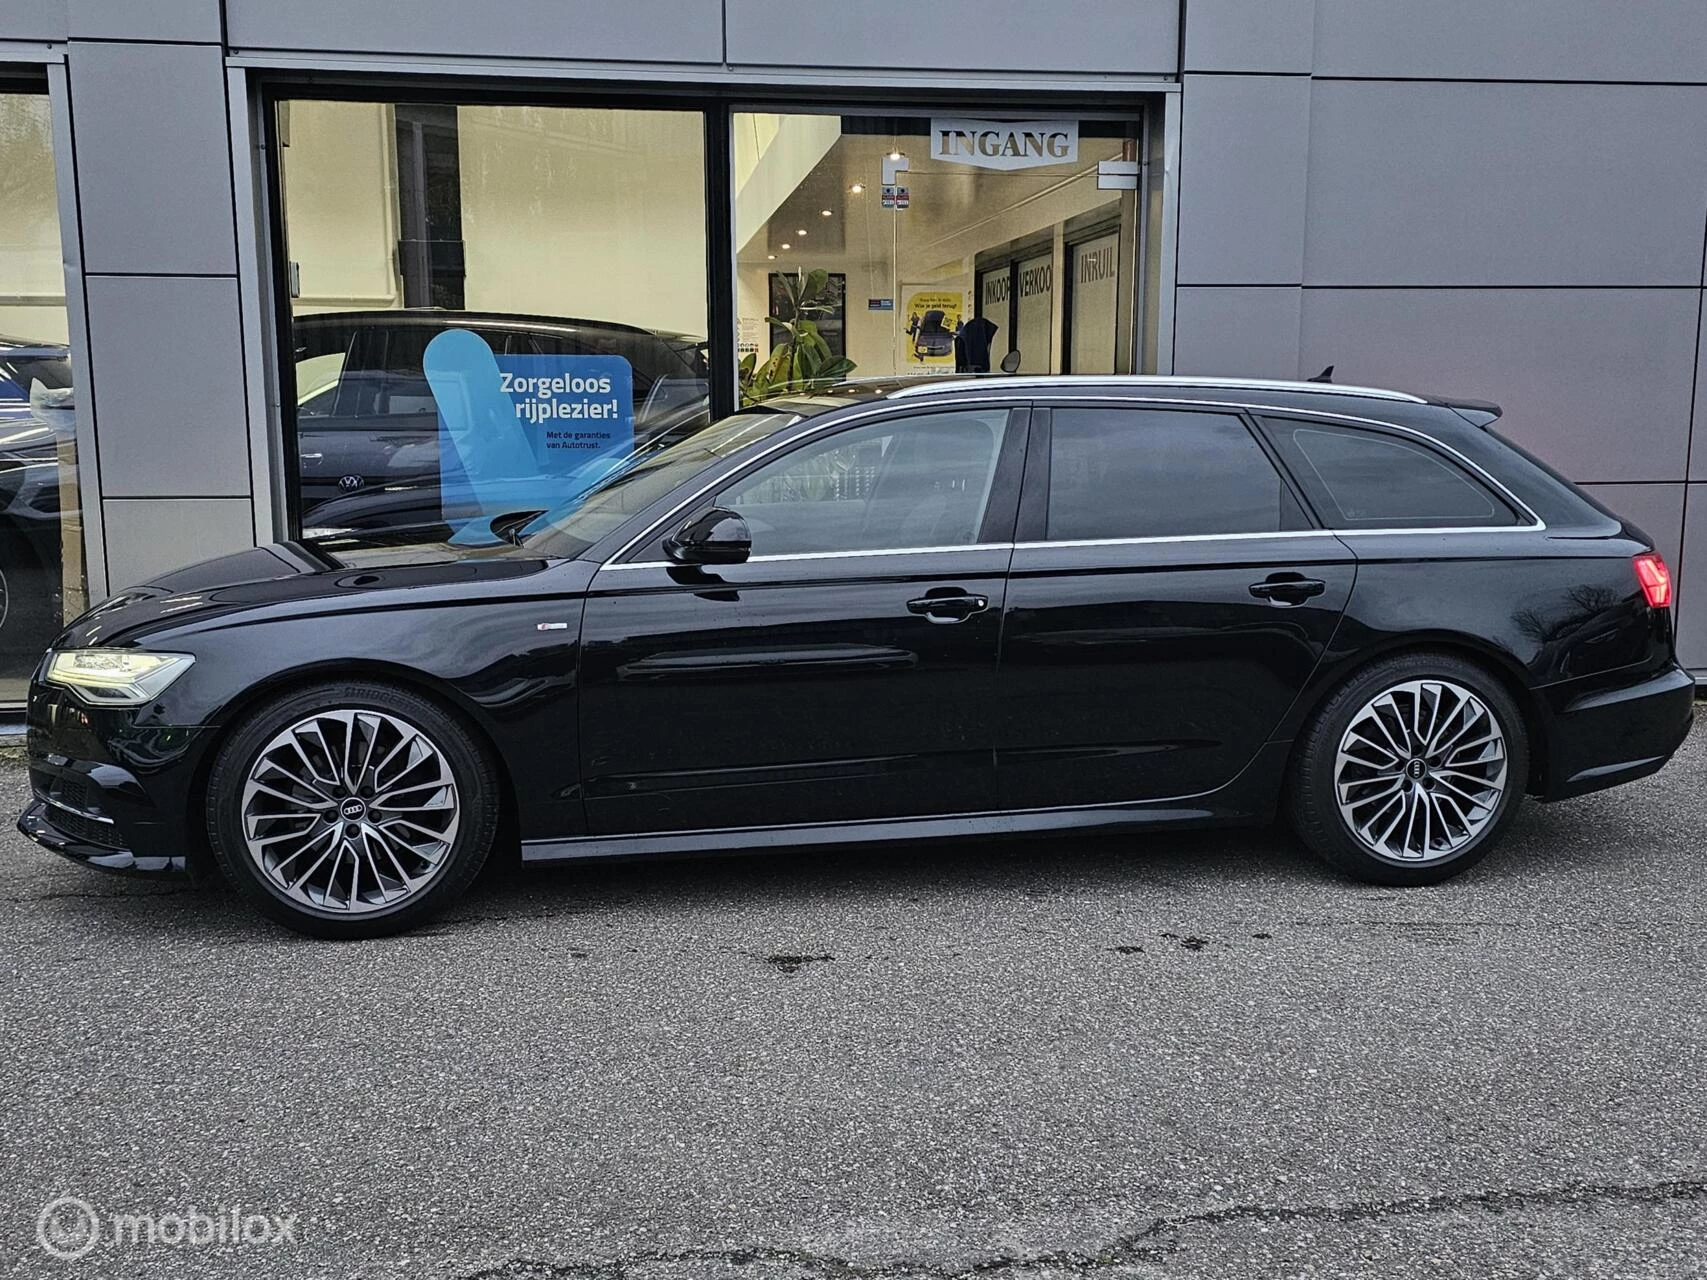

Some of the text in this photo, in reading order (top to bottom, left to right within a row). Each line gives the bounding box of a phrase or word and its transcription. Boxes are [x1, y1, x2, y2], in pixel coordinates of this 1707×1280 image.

[939, 130, 1069, 158] INGANG
[1081, 246, 1116, 284] INRUIL
[1019, 264, 1053, 298] VERKOO
[500, 373, 611, 398] Zorgeloos
[515, 398, 618, 424] rijplezier!
[546, 431, 611, 441] Met de garanties
[561, 441, 601, 449] Autotrust.
